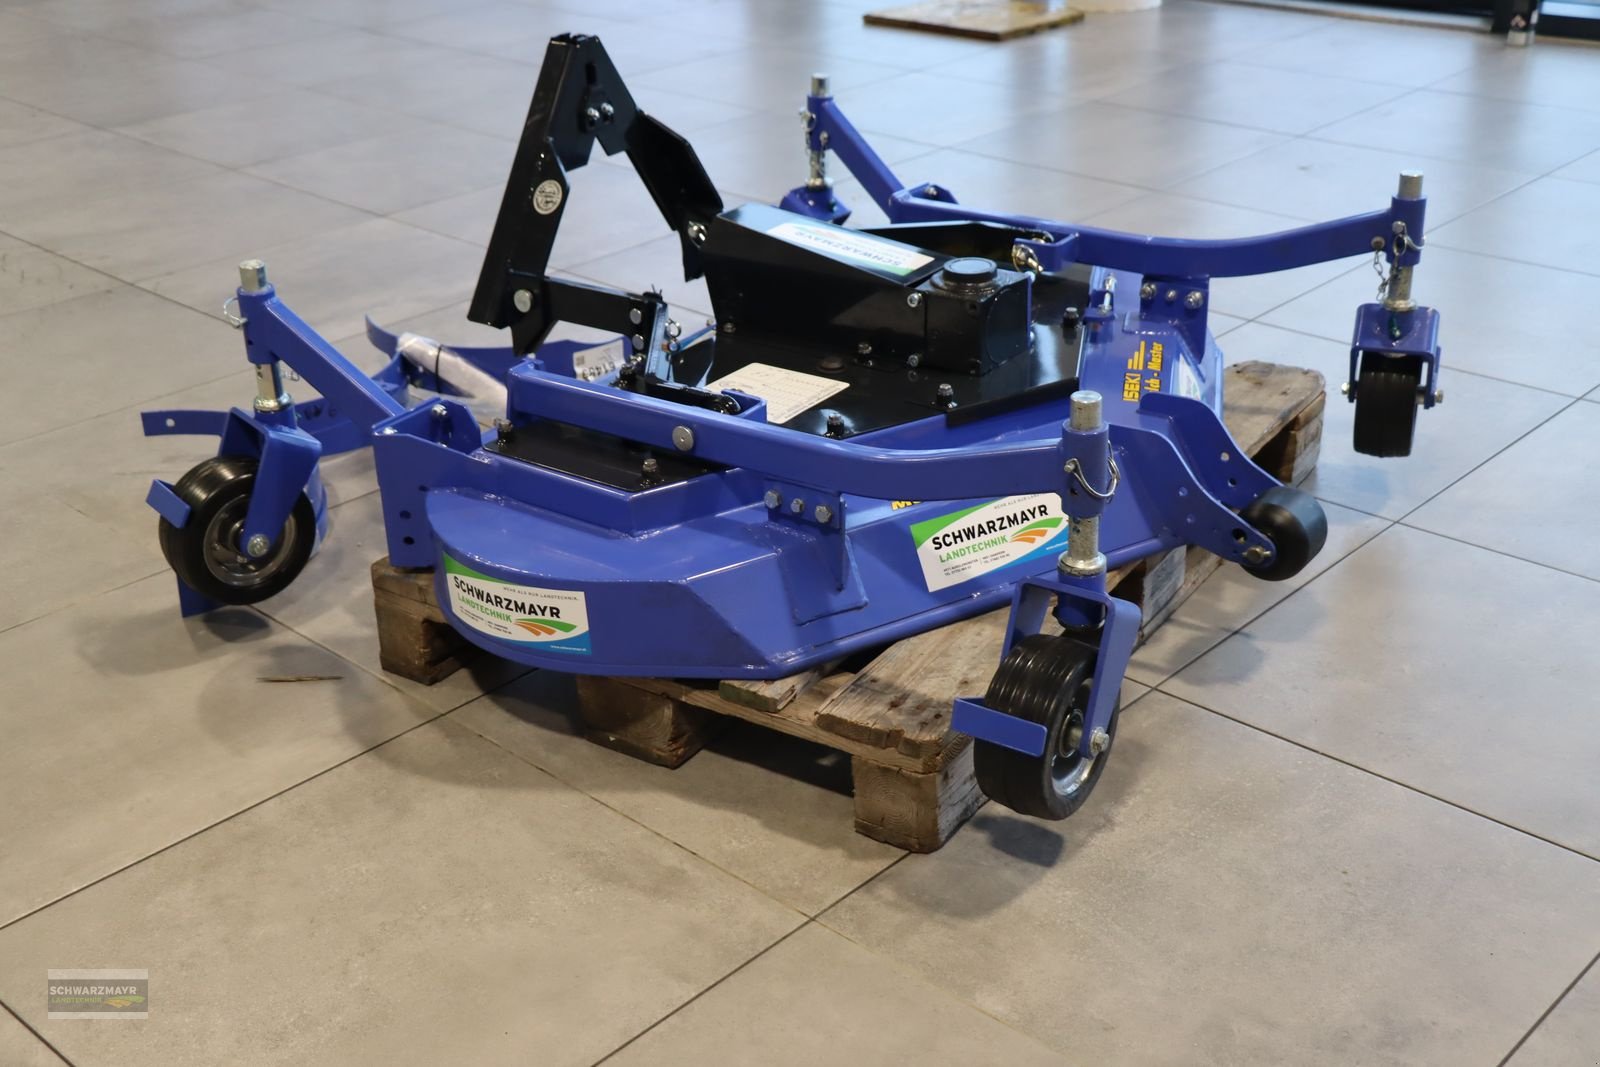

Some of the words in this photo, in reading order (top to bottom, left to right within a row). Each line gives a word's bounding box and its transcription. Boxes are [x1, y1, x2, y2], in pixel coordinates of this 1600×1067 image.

[795, 231, 902, 267] SCHWARZMAYR
[1147, 341, 1163, 371] Master
[1123, 373, 1141, 402] ISEKI
[1144, 378, 1161, 393] lch
[932, 504, 1049, 551] SCHWARZMAYR
[939, 535, 1009, 563] LANDTECHNIK
[453, 575, 561, 619] SCHWARZMAYR
[457, 592, 512, 624] LANDTECHNIK
